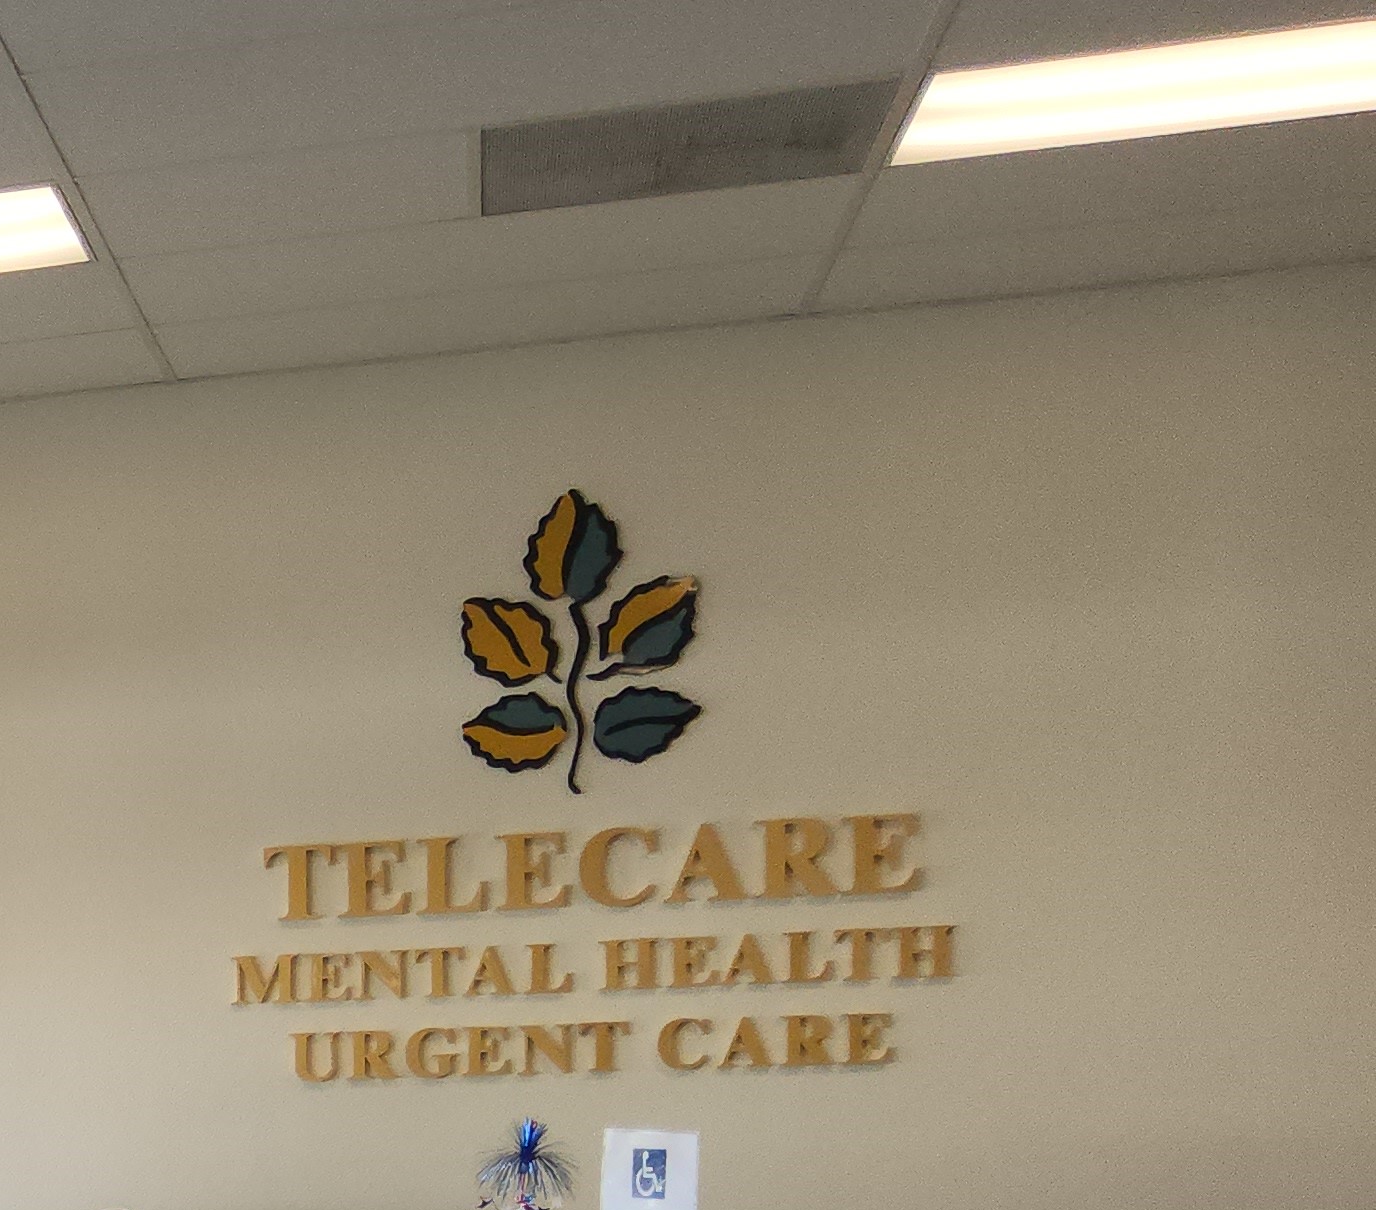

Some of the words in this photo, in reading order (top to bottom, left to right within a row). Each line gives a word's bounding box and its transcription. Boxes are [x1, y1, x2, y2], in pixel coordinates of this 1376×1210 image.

[263, 813, 925, 921] TELECARE
[231, 943, 575, 1006] MENTAL
[598, 924, 958, 989] HEALTH
[290, 1021, 633, 1082] URGENT
[657, 1013, 898, 1071] CARE
